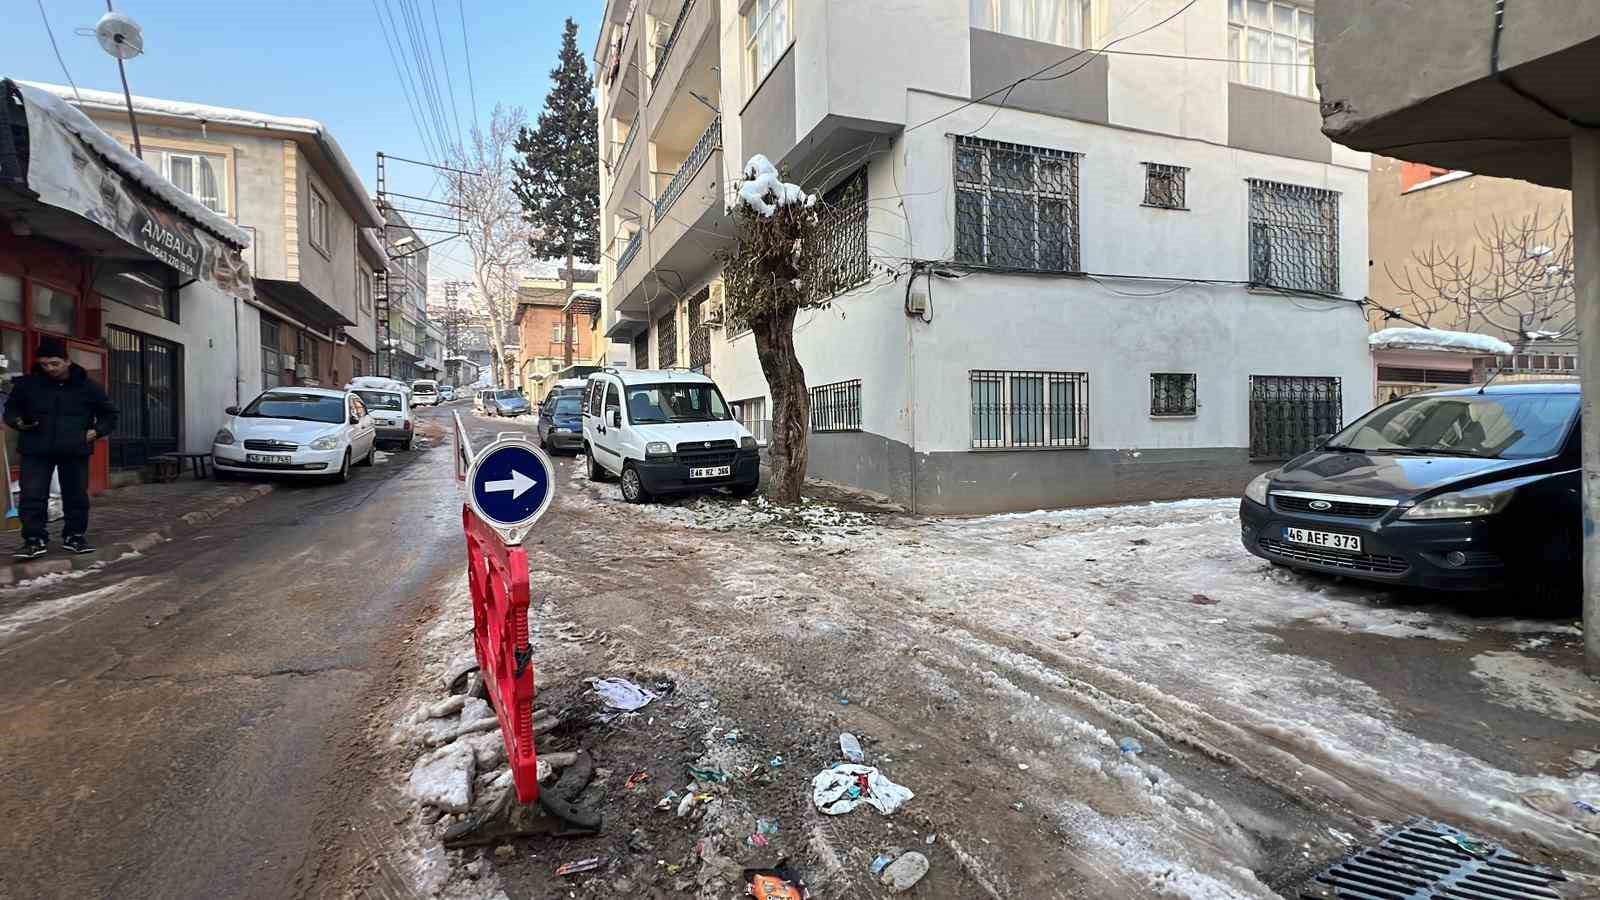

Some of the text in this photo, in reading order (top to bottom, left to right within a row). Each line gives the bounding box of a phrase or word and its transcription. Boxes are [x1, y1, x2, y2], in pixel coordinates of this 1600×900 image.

[141, 219, 199, 264] AMBALAJ
[1289, 529, 1358, 549] 46 AEF 373
